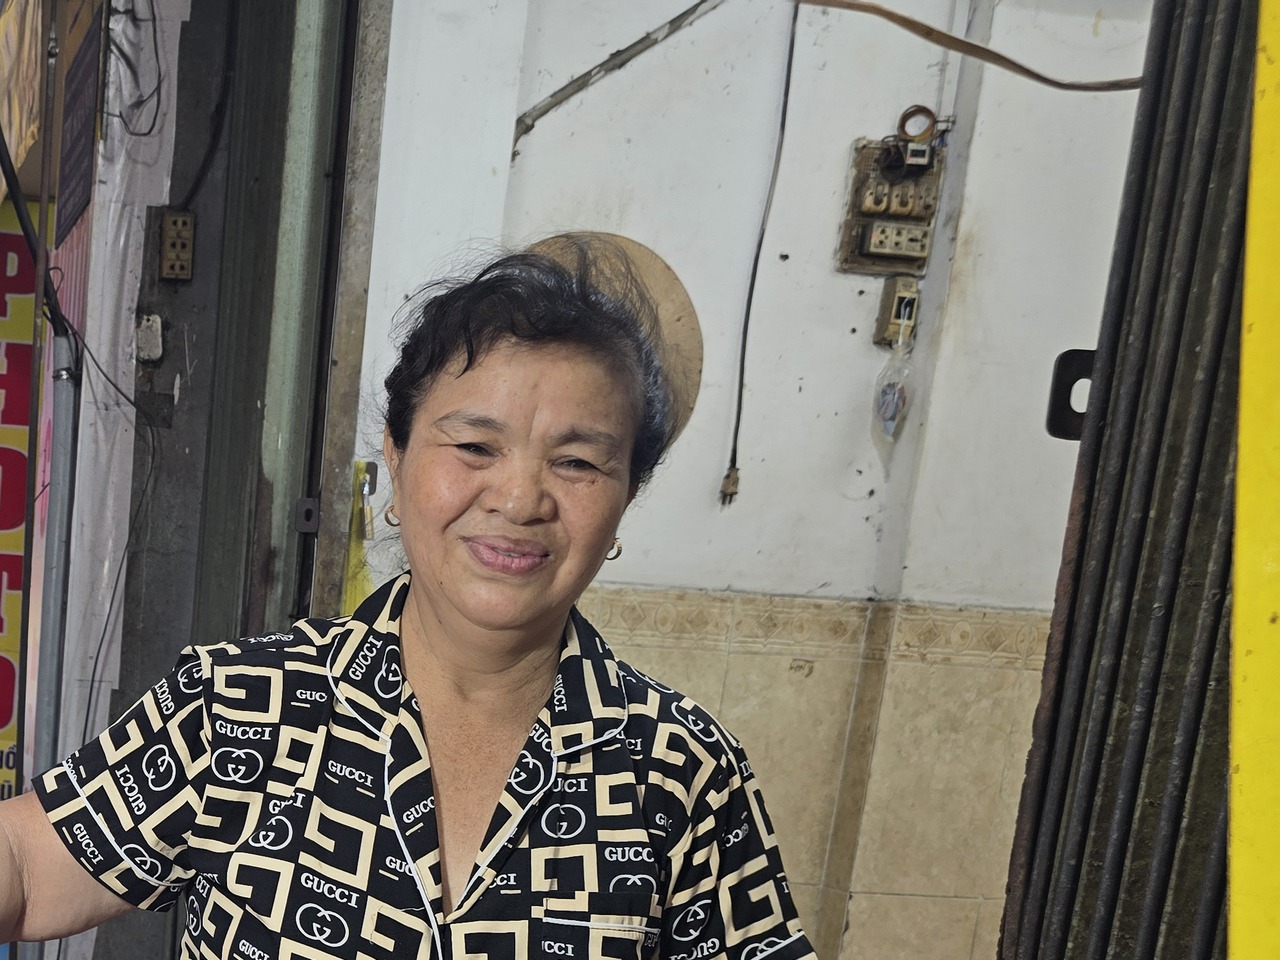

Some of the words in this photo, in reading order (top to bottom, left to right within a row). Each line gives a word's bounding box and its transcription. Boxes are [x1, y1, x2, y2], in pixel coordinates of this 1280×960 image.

[349, 635, 383, 681] GUCCI
[216, 720, 273, 741] GUCCI
[115, 764, 147, 816] GUCCI
[328, 760, 374, 788] GUCCI
[73, 823, 104, 865] GUCCI
[300, 871, 359, 908] GUCCI
[542, 940, 575, 957] CCI
